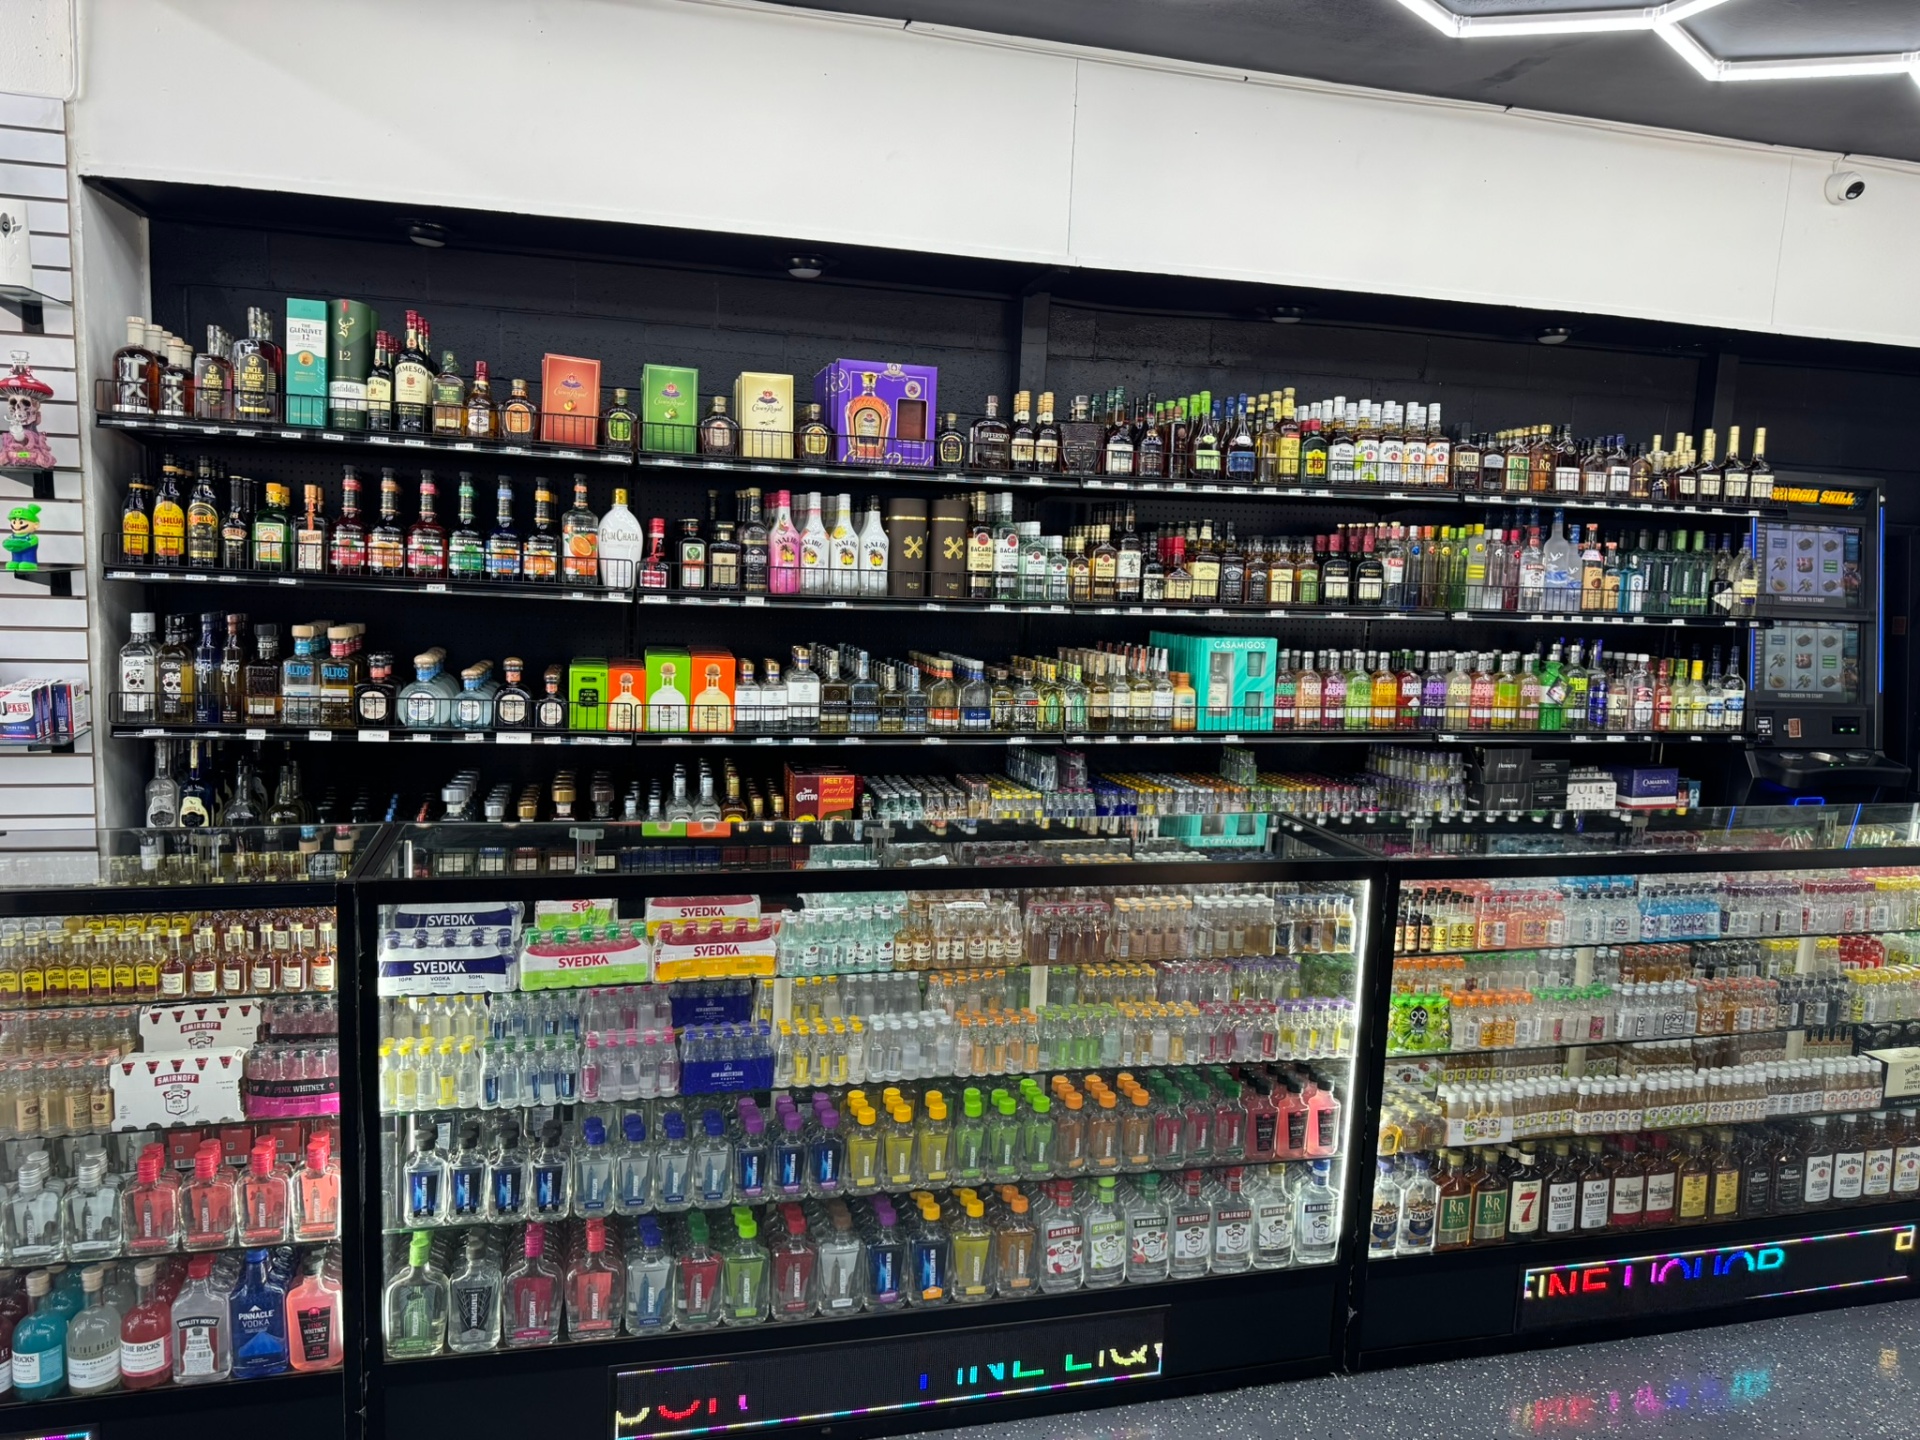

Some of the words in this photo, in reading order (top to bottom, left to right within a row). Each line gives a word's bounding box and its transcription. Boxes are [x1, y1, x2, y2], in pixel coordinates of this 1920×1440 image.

[289, 328, 322, 336] GLENLIVET
[338, 350, 352, 361] 12
[244, 366, 262, 374] UNCLE
[242, 373, 265, 382] NEAREST
[752, 404, 768, 412] Crown
[766, 405, 783, 413] Royal
[1820, 490, 1855, 506] SKILL
[154, 515, 184, 528] KAHLÚA
[1214, 640, 1266, 650] CASAMIGOS
[286, 664, 312, 676] ALTOS
[322, 666, 349, 678] ALTOS
[1642, 778, 1670, 787] CAMARENA
[796, 792, 818, 802] Cuervo
[680, 907, 726, 918] SVEDKA
[428, 914, 475, 926] SVEDKA
[694, 945, 740, 957] SVEDKA
[558, 954, 609, 968] SVEDKA
[413, 961, 466, 974] SVEDKA
[1410, 1011, 1428, 1025] 99
[183, 1022, 219, 1032] SMIRNOFF
[157, 1074, 196, 1085] SMIRNOFF
[274, 1086, 292, 1094] PINK
[293, 1084, 326, 1093] WHITNEY
[1839, 1158, 1851, 1168] JIM
[1851, 1158, 1862, 1166] BEAM
[1869, 1156, 1880, 1166] JIM
[1879, 1154, 1890, 1163] BEAM
[1899, 1154, 1910, 1163] JIM
[1811, 1162, 1821, 1172] JIM
[1584, 1191, 1608, 1199] KENTUCKY
[1450, 1200, 1465, 1215] RR
[1485, 1195, 1500, 1210] RR
[1518, 1191, 1537, 1223] 7
[1179, 1215, 1208, 1224] SMIRNOFF
[1220, 1211, 1251, 1220] SMIRNOFF
[1374, 1214, 1397, 1224] TAAKA
[1410, 1210, 1434, 1220] TAAKA
[1093, 1221, 1124, 1233] SMIRNOFF
[1136, 1218, 1167, 1227] SMIRNOFF
[1050, 1226, 1081, 1238] SMIRNOFF
[238, 1310, 274, 1320] PINNACLE
[179, 1319, 199, 1327] QUALITY
[242, 1319, 270, 1328] VODKA
[136, 1342, 161, 1352] ROCKS
